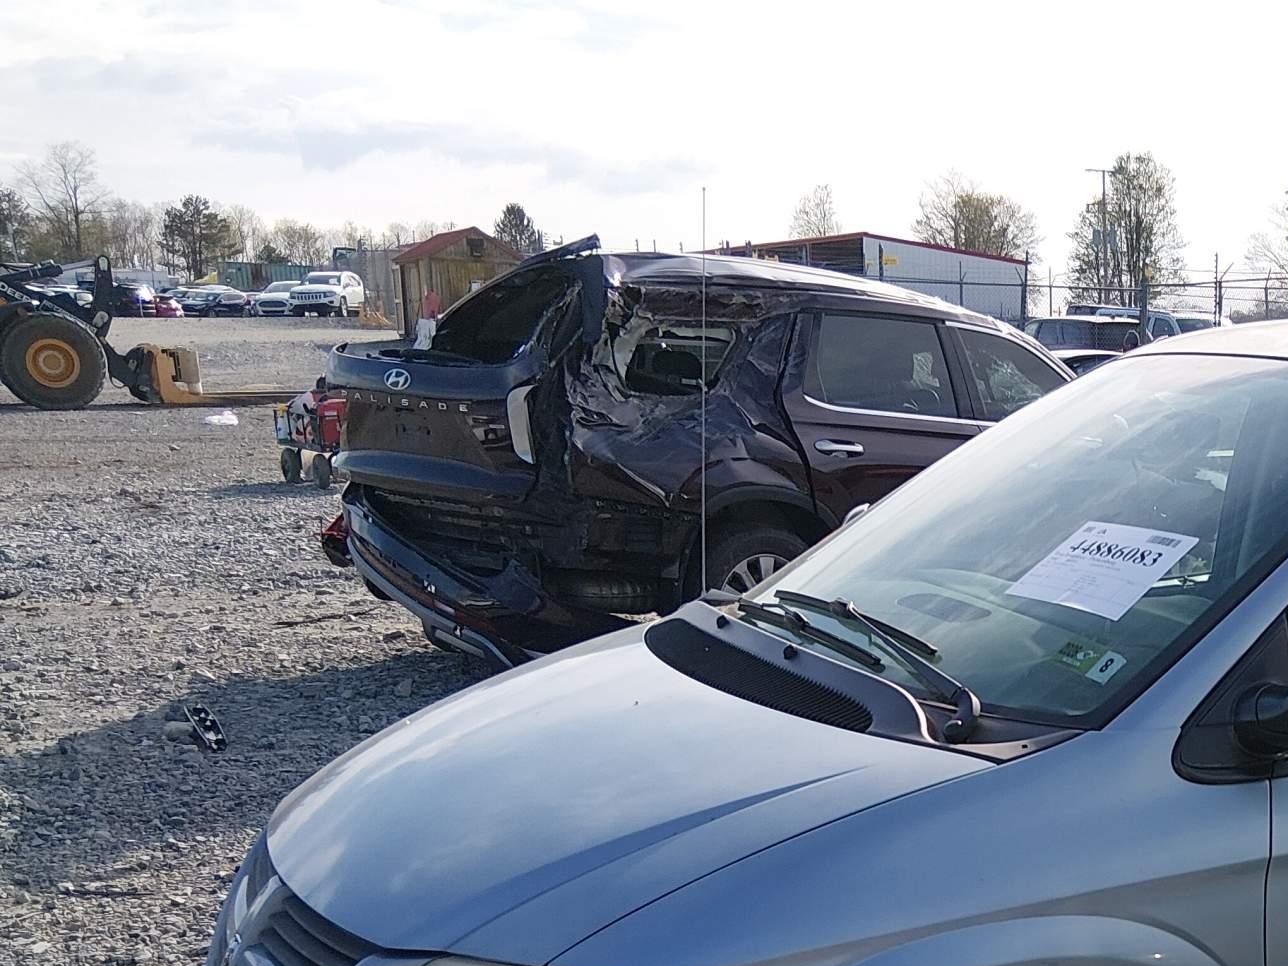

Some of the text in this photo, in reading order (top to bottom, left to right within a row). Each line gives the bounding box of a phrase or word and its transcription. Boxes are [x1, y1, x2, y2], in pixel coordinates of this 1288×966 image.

[0, 281, 32, 302] DEER
[341, 389, 469, 411] PALISADE
[1069, 539, 1164, 568] 44886083
[1098, 657, 1115, 673] 8
